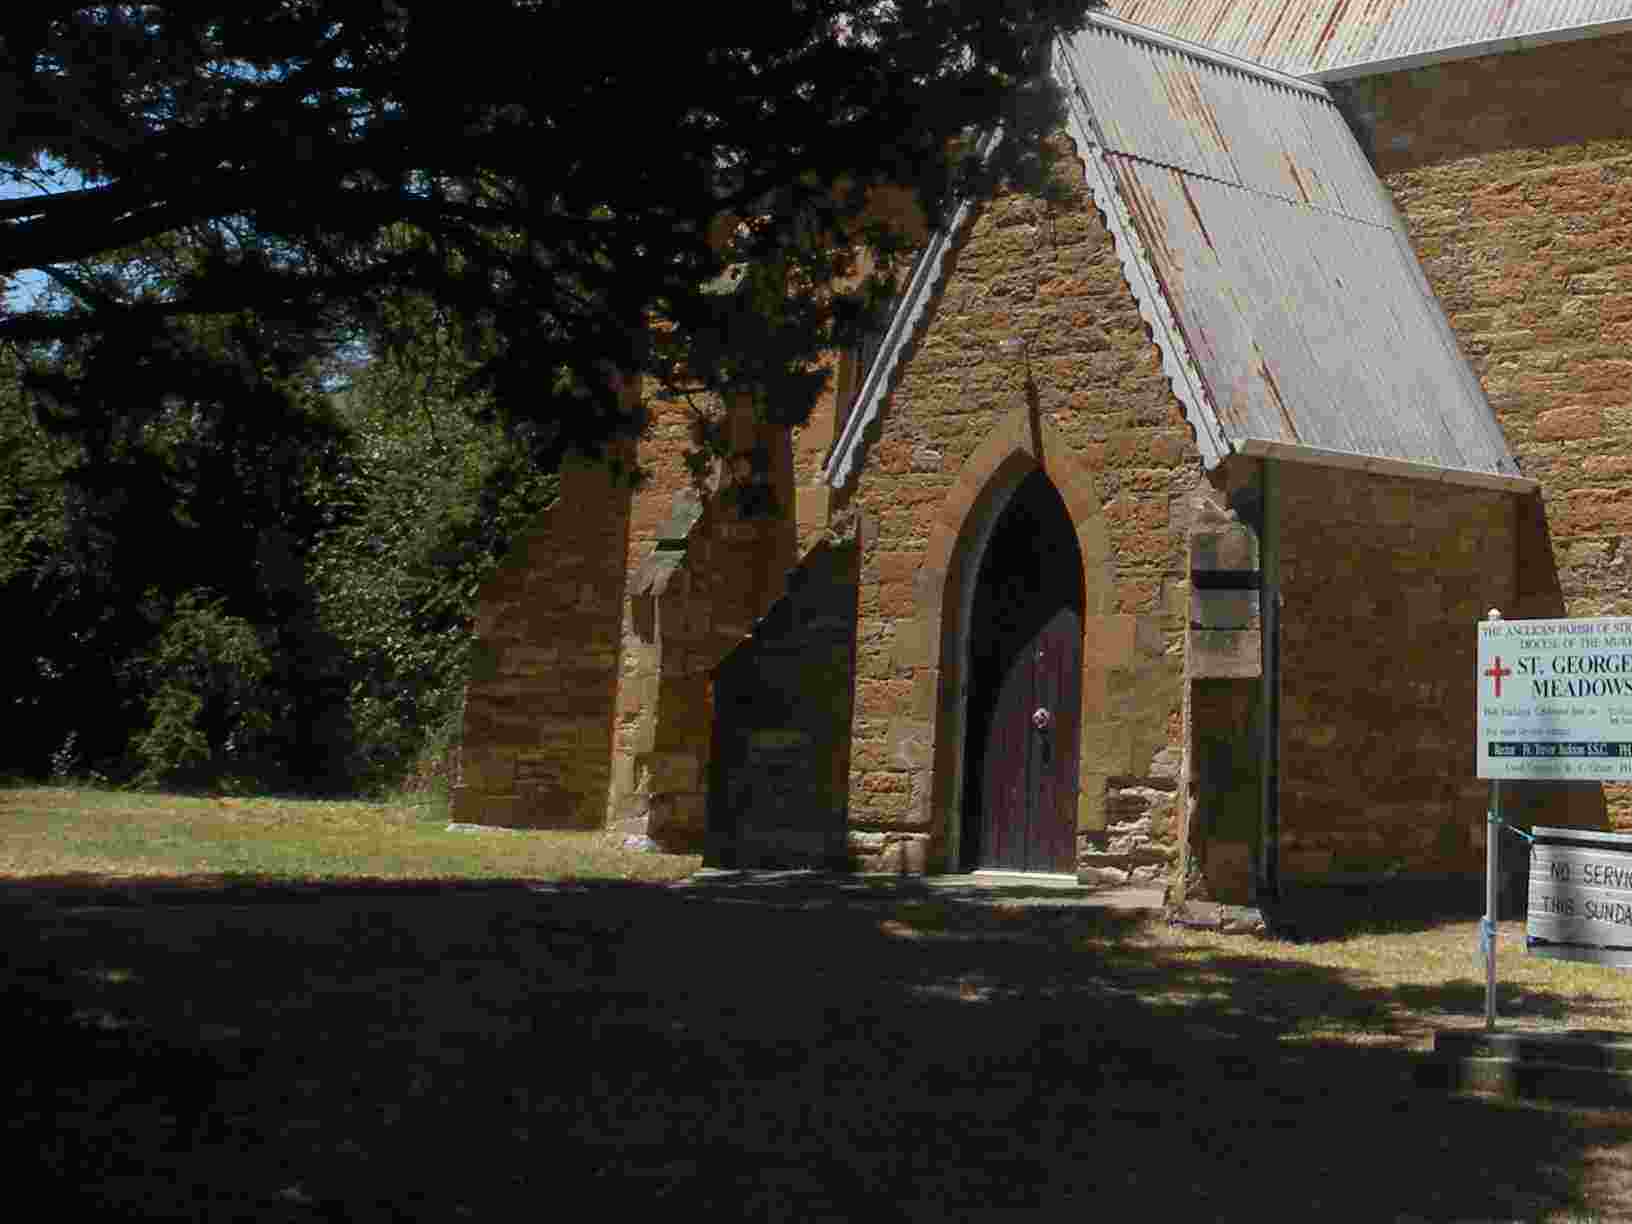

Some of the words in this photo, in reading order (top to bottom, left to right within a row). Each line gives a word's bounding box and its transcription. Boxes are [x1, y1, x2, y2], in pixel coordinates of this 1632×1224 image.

[1563, 637, 1576, 648] OF
[1580, 637, 1600, 648] THE
[1551, 861, 1570, 881] NO
[1542, 896, 1575, 914] THIS
